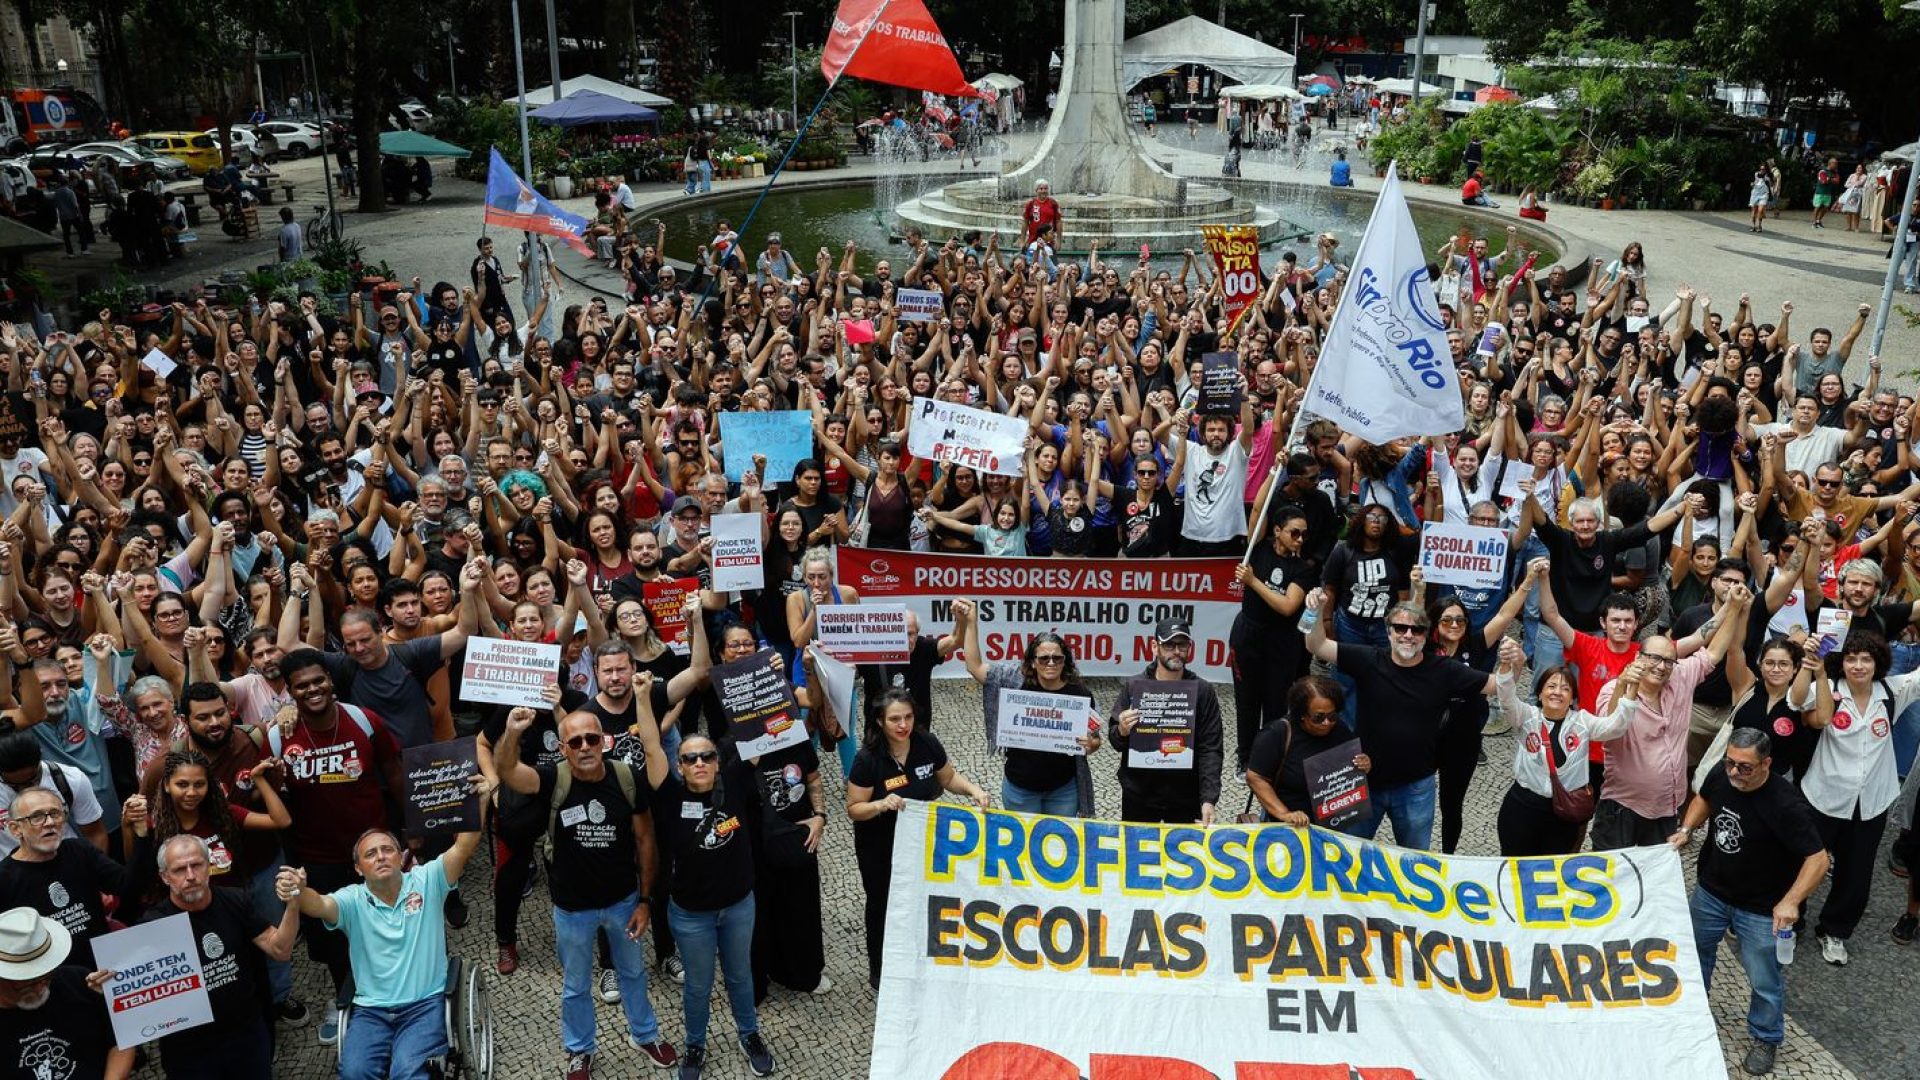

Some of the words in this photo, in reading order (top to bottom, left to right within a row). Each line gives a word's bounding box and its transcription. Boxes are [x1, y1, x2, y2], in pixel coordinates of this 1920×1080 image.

[740, 538, 756, 546] TEM
[1423, 535, 1473, 554] ESCOLA
[1477, 538, 1505, 557] NÃO
[719, 558, 736, 567] TEM
[1422, 549, 1432, 567] É
[1434, 553, 1492, 573] QUARTEL
[913, 566, 1113, 592] PROFESSORES/AS
[1120, 570, 1153, 592] EM
[1160, 572, 1214, 594] LUTA
[820, 613, 865, 624] CORRIGIR
[867, 612, 904, 623] PROVAS
[931, 600, 995, 622] MS
[1002, 600, 1130, 625] TRABALHO
[820, 623, 853, 634] TAMBÉM
[855, 622, 860, 634] É
[861, 624, 906, 634] TRABALHO!
[470, 650, 520, 665] RELATÓRIOS
[521, 655, 556, 669] TAMBÉM
[490, 643, 538, 657] PREENCHER
[474, 664, 481, 679] É
[484, 668, 545, 686] TRABALHO!
[754, 674, 777, 688] prova
[755, 666, 773, 677] aula
[754, 679, 787, 696] material
[1024, 706, 1064, 720] TAMBÉM
[1163, 708, 1195, 716] material
[1012, 713, 1019, 726] É
[1020, 716, 1073, 732] TRABALHO!
[1329, 791, 1362, 811] GREVE
[576, 824, 617, 833] EDUCAÇÃO
[929, 803, 1447, 916] PROFESSORAS
[926, 894, 1208, 979] ESCOLAS
[1230, 912, 1682, 1006] PARTICULARES
[113, 957, 155, 982] ONDE
[155, 951, 187, 969] TEM
[202, 953, 237, 973] DUCAÇÃO
[111, 963, 195, 997] EDUCAÇÃO,
[203, 969, 216, 980] EM
[206, 975, 239, 992] DIGITAL
[119, 991, 151, 1009] TEM
[153, 978, 193, 1001] LUTA!
[1267, 988, 1358, 1034] EM
